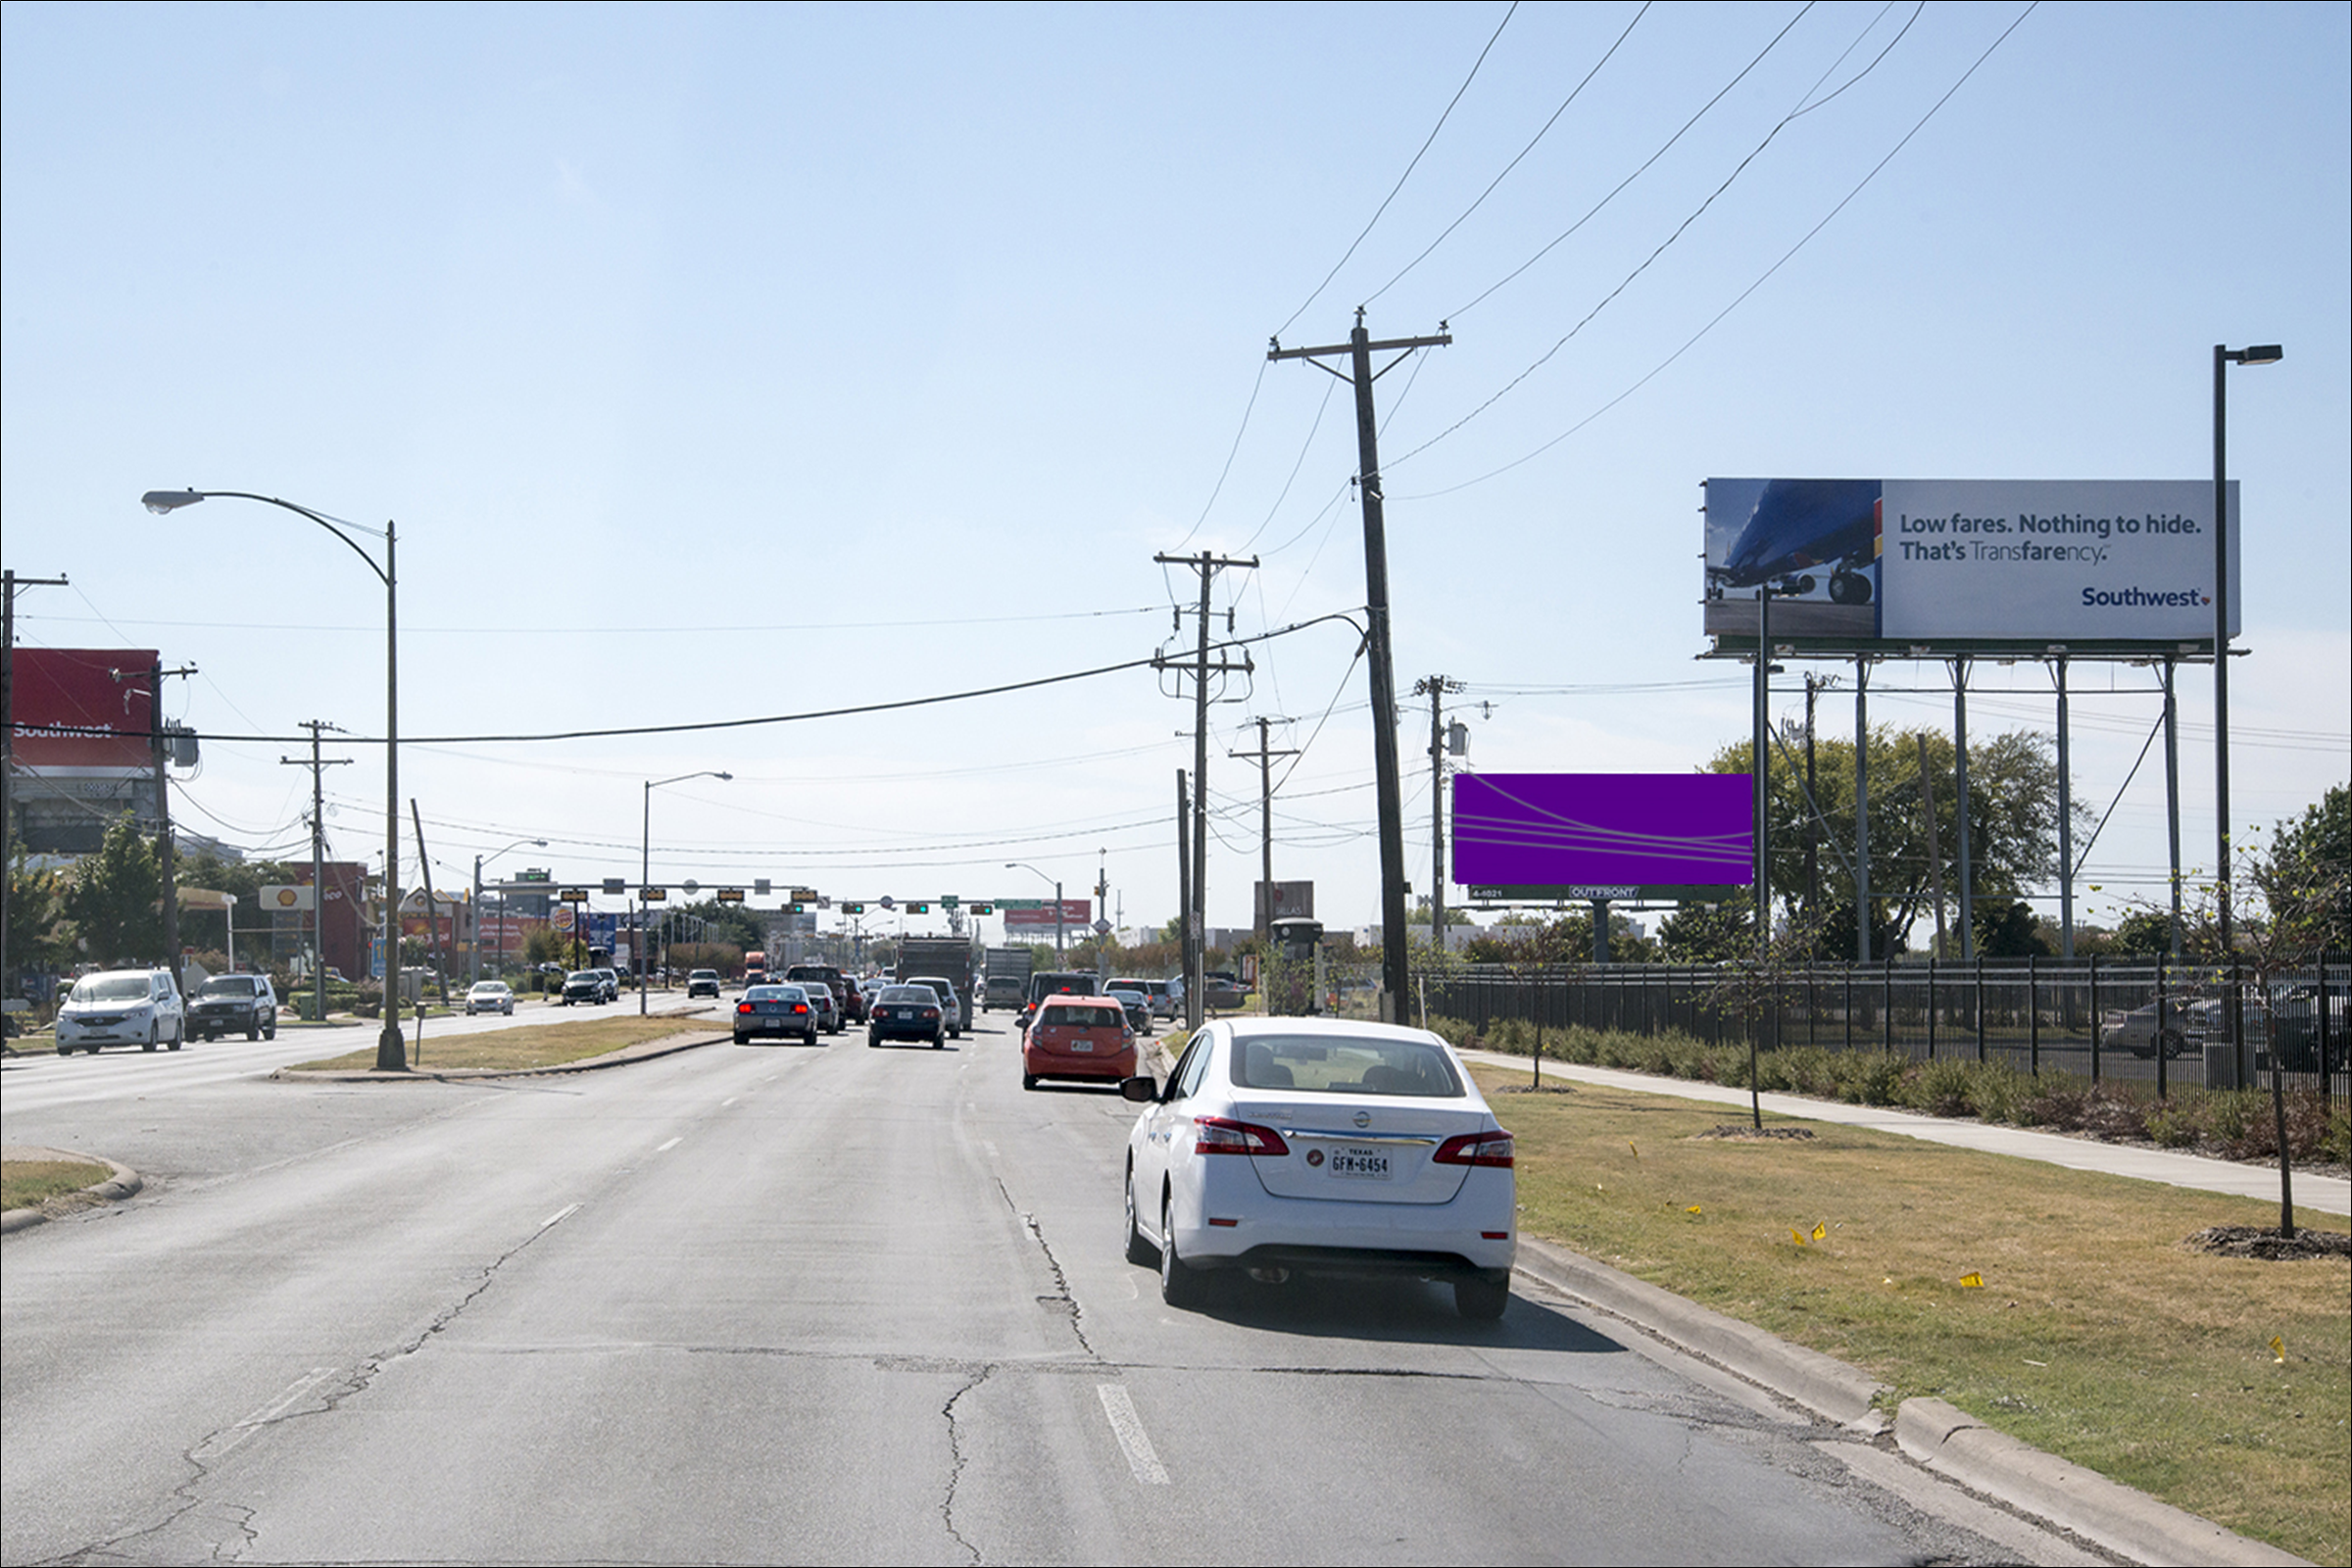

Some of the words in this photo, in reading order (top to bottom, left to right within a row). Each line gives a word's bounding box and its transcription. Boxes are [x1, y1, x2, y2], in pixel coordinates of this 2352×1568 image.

[1900, 514, 1946, 533] Low
[1951, 513, 2012, 533] fares.
[2019, 513, 2110, 538] Nothing
[2116, 516, 2140, 534] to
[2146, 514, 2201, 534] hide.
[1899, 541, 1966, 561] That's
[2082, 587, 2199, 607] Southwest
[14, 721, 112, 738] Southwest
[1571, 886, 1635, 898] OUTFRONT
